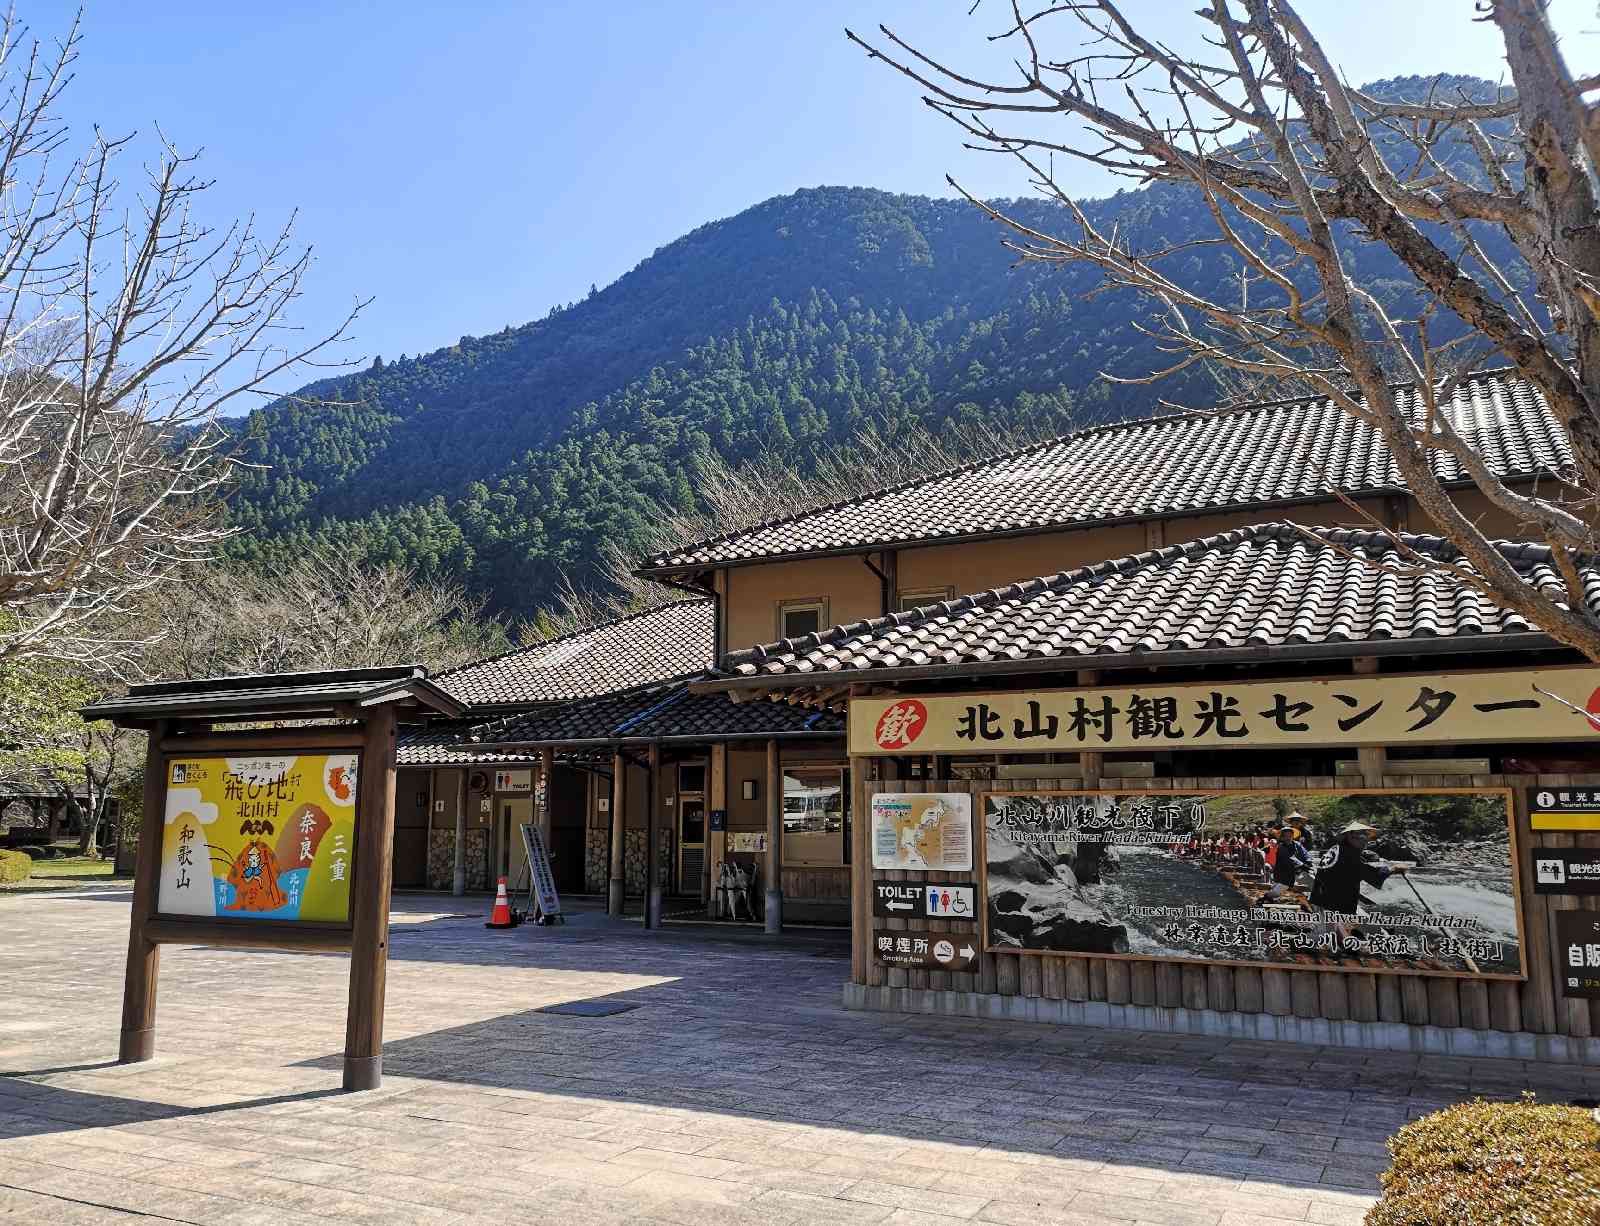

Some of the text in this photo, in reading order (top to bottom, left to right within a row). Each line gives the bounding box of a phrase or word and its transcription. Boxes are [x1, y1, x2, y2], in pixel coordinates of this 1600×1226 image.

[956, 686, 1541, 742] 北山村観光センター
[236, 802, 280, 818] 北山村
[994, 804, 1206, 830] 北山川観光筏下り
[299, 810, 317, 861] 奈良
[1010, 831, 1066, 845] Kitayama
[1069, 831, 1101, 843] River
[176, 824, 195, 889] 和歌山
[329, 834, 348, 883] 三重
[877, 886, 923, 899] TOILET
[1127, 904, 1183, 920] Forestry
[1186, 904, 1247, 922] Heritage
[1250, 907, 1321, 925] Kitayama
[878, 936, 929, 954] 喫煙所
